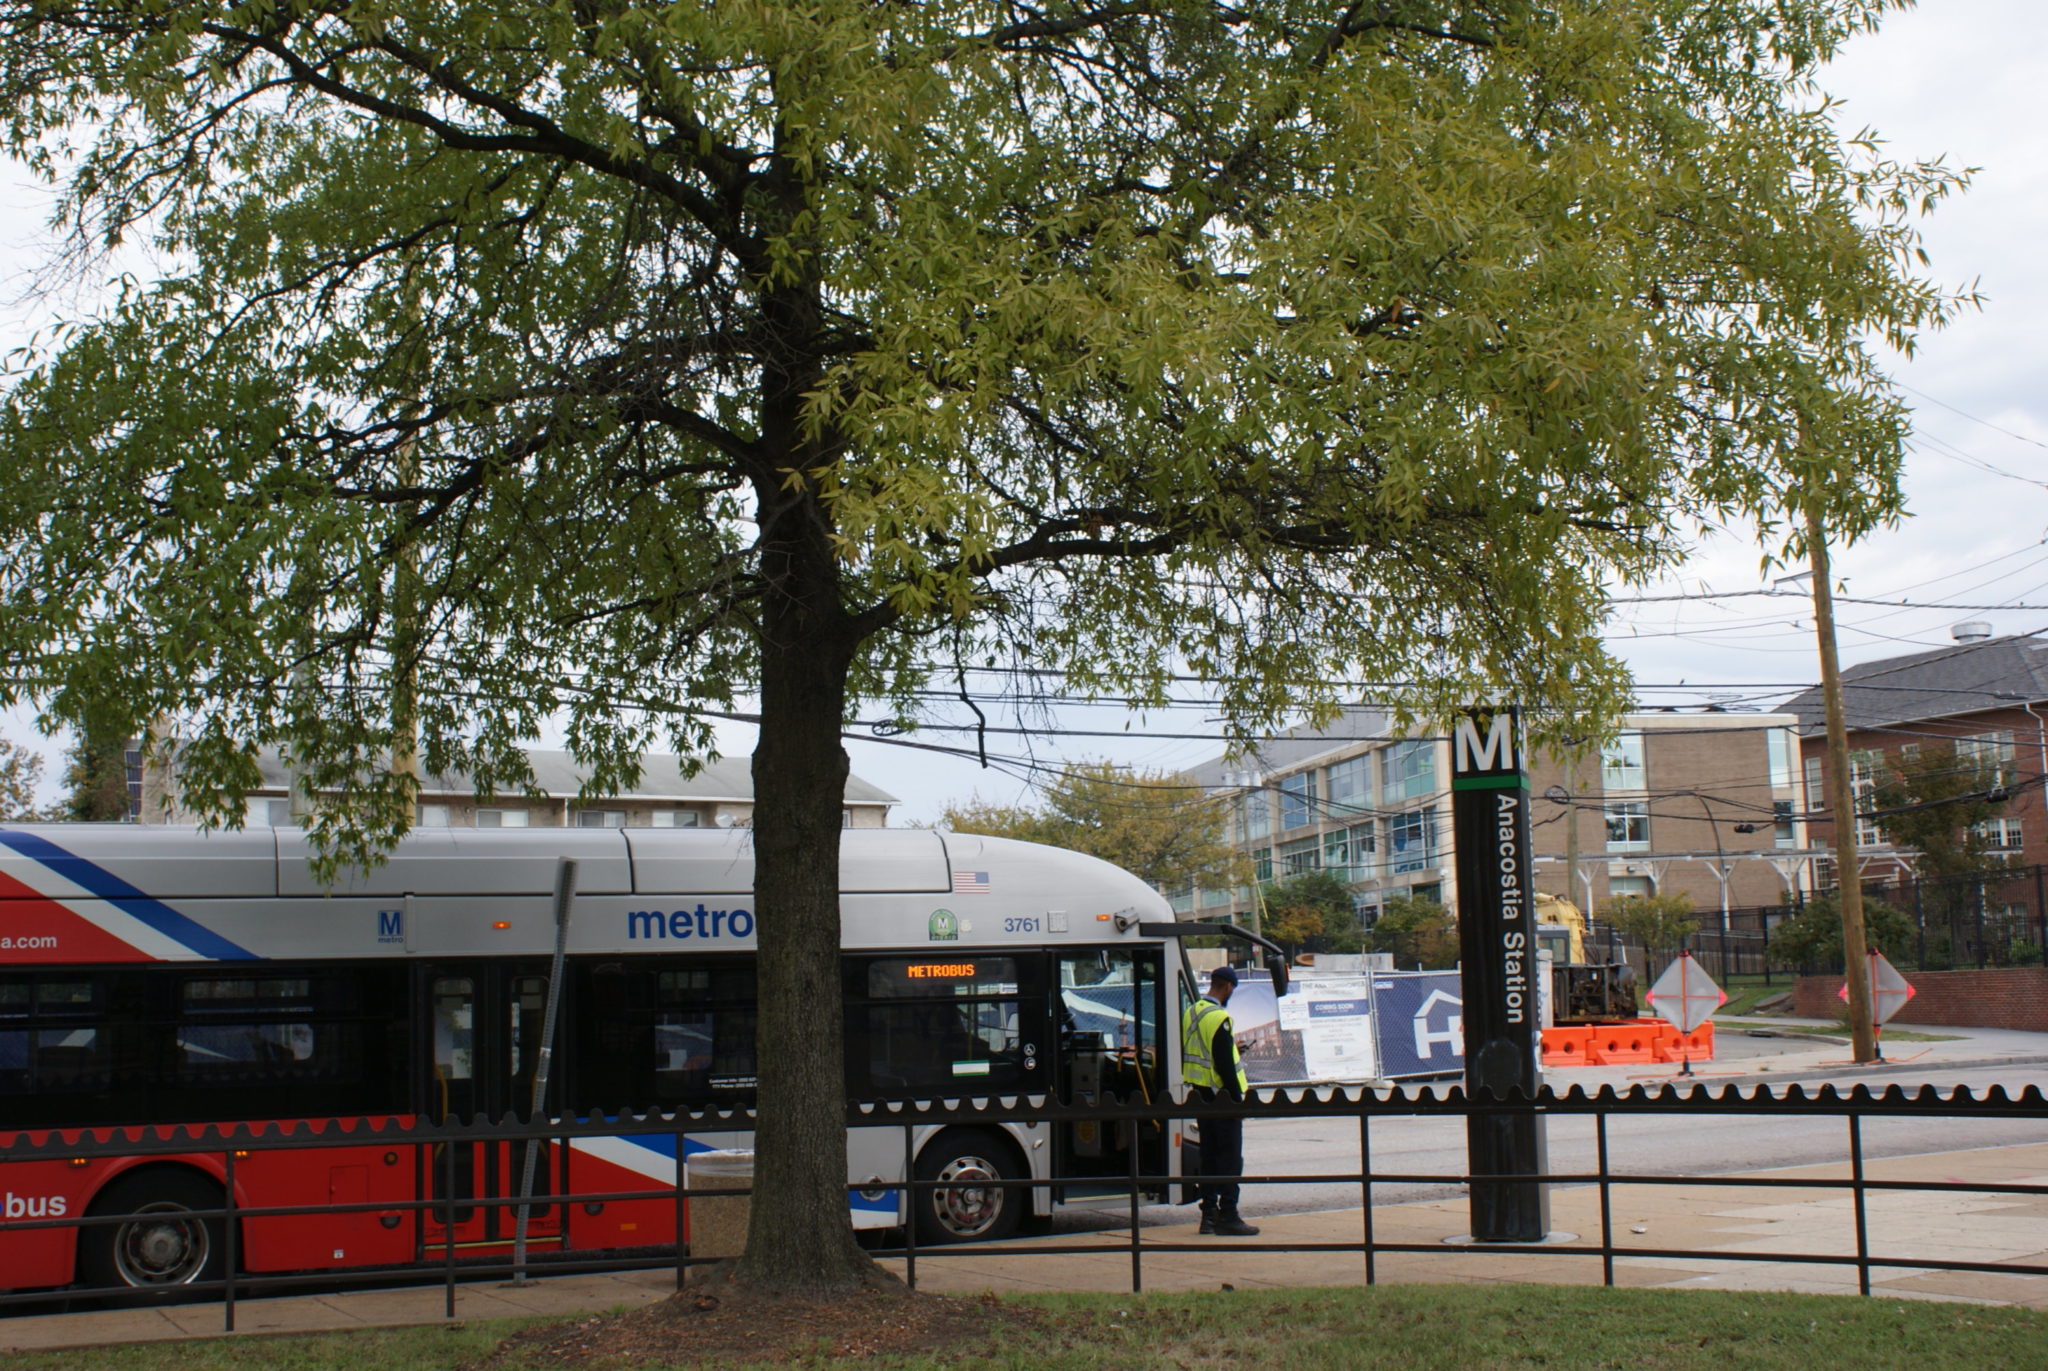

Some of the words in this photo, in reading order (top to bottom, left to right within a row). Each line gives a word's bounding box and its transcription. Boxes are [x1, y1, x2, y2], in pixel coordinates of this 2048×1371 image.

[1455, 714, 1513, 773] M
[1497, 794, 1522, 920] Anacostia
[380, 911, 401, 935] M
[937, 918, 949, 929] M
[1004, 918, 1040, 932] 3761
[907, 964, 975, 978] METROBUS
[1503, 932, 1527, 1024] Station
[0, 1192, 67, 1218] bus
